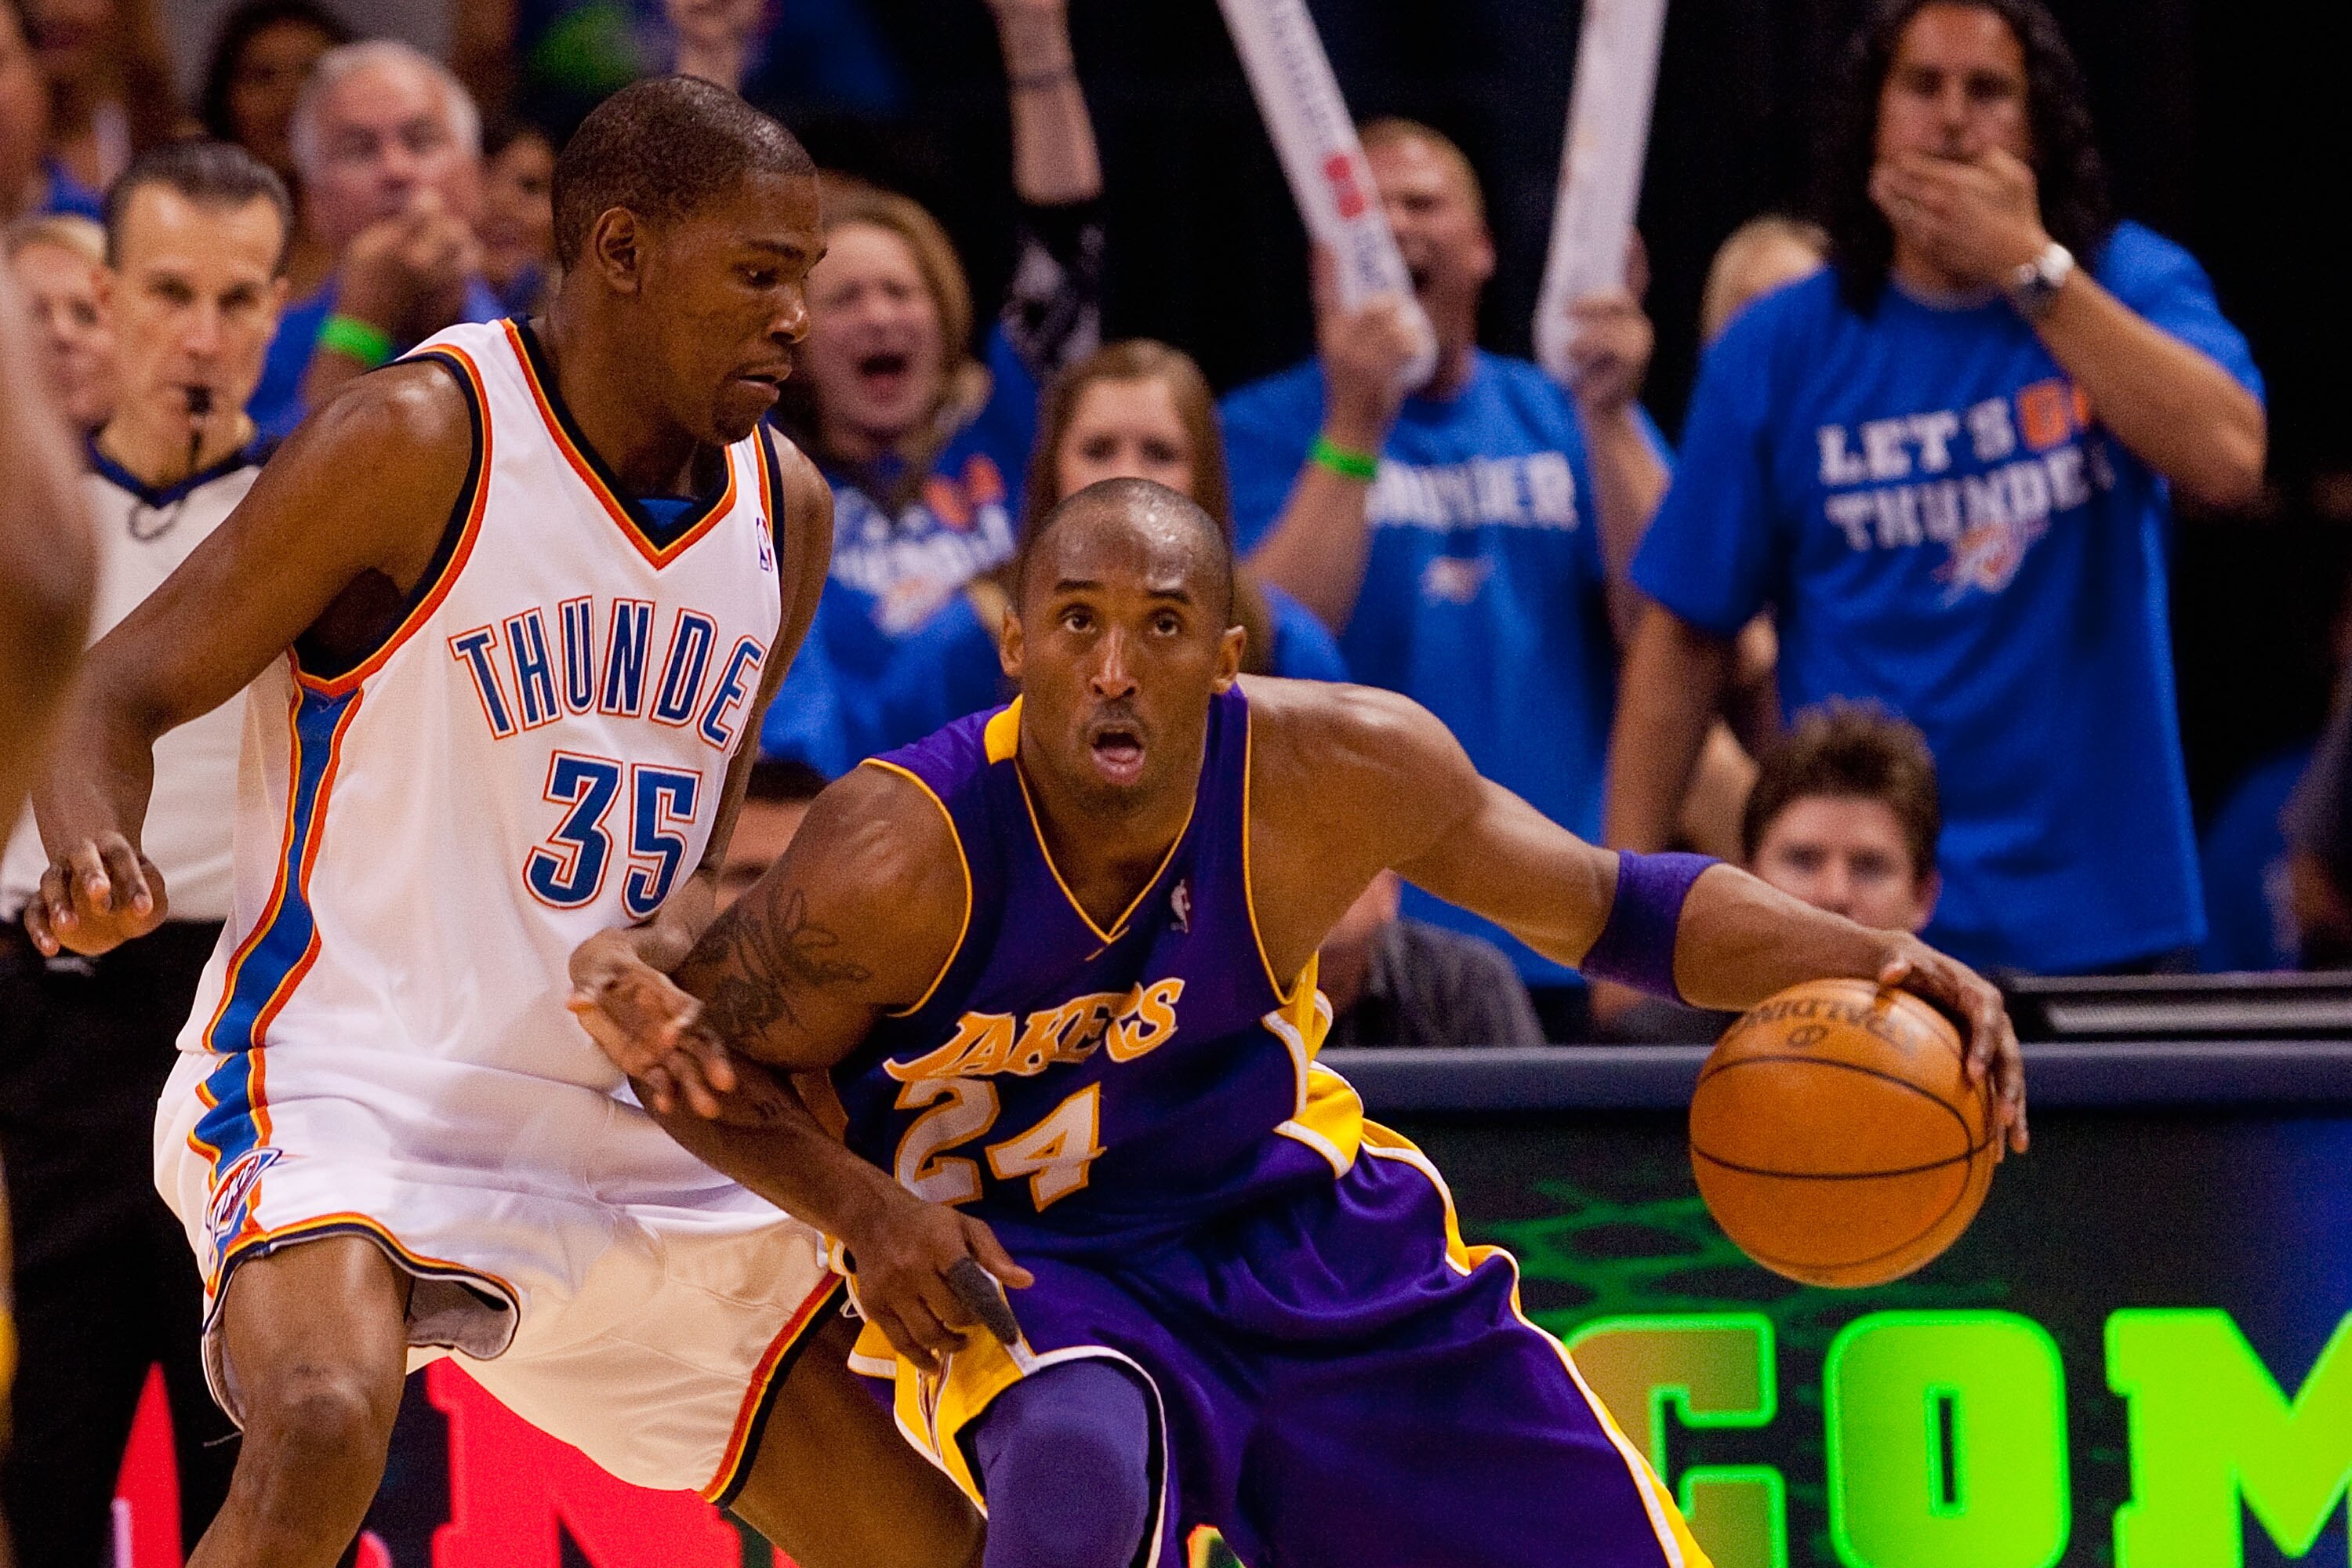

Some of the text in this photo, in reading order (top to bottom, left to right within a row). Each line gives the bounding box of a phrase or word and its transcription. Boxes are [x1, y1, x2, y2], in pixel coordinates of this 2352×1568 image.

[448, 595, 766, 757] THUNDE
[522, 750, 703, 919] 35
[894, 1077, 1107, 1213] 24
